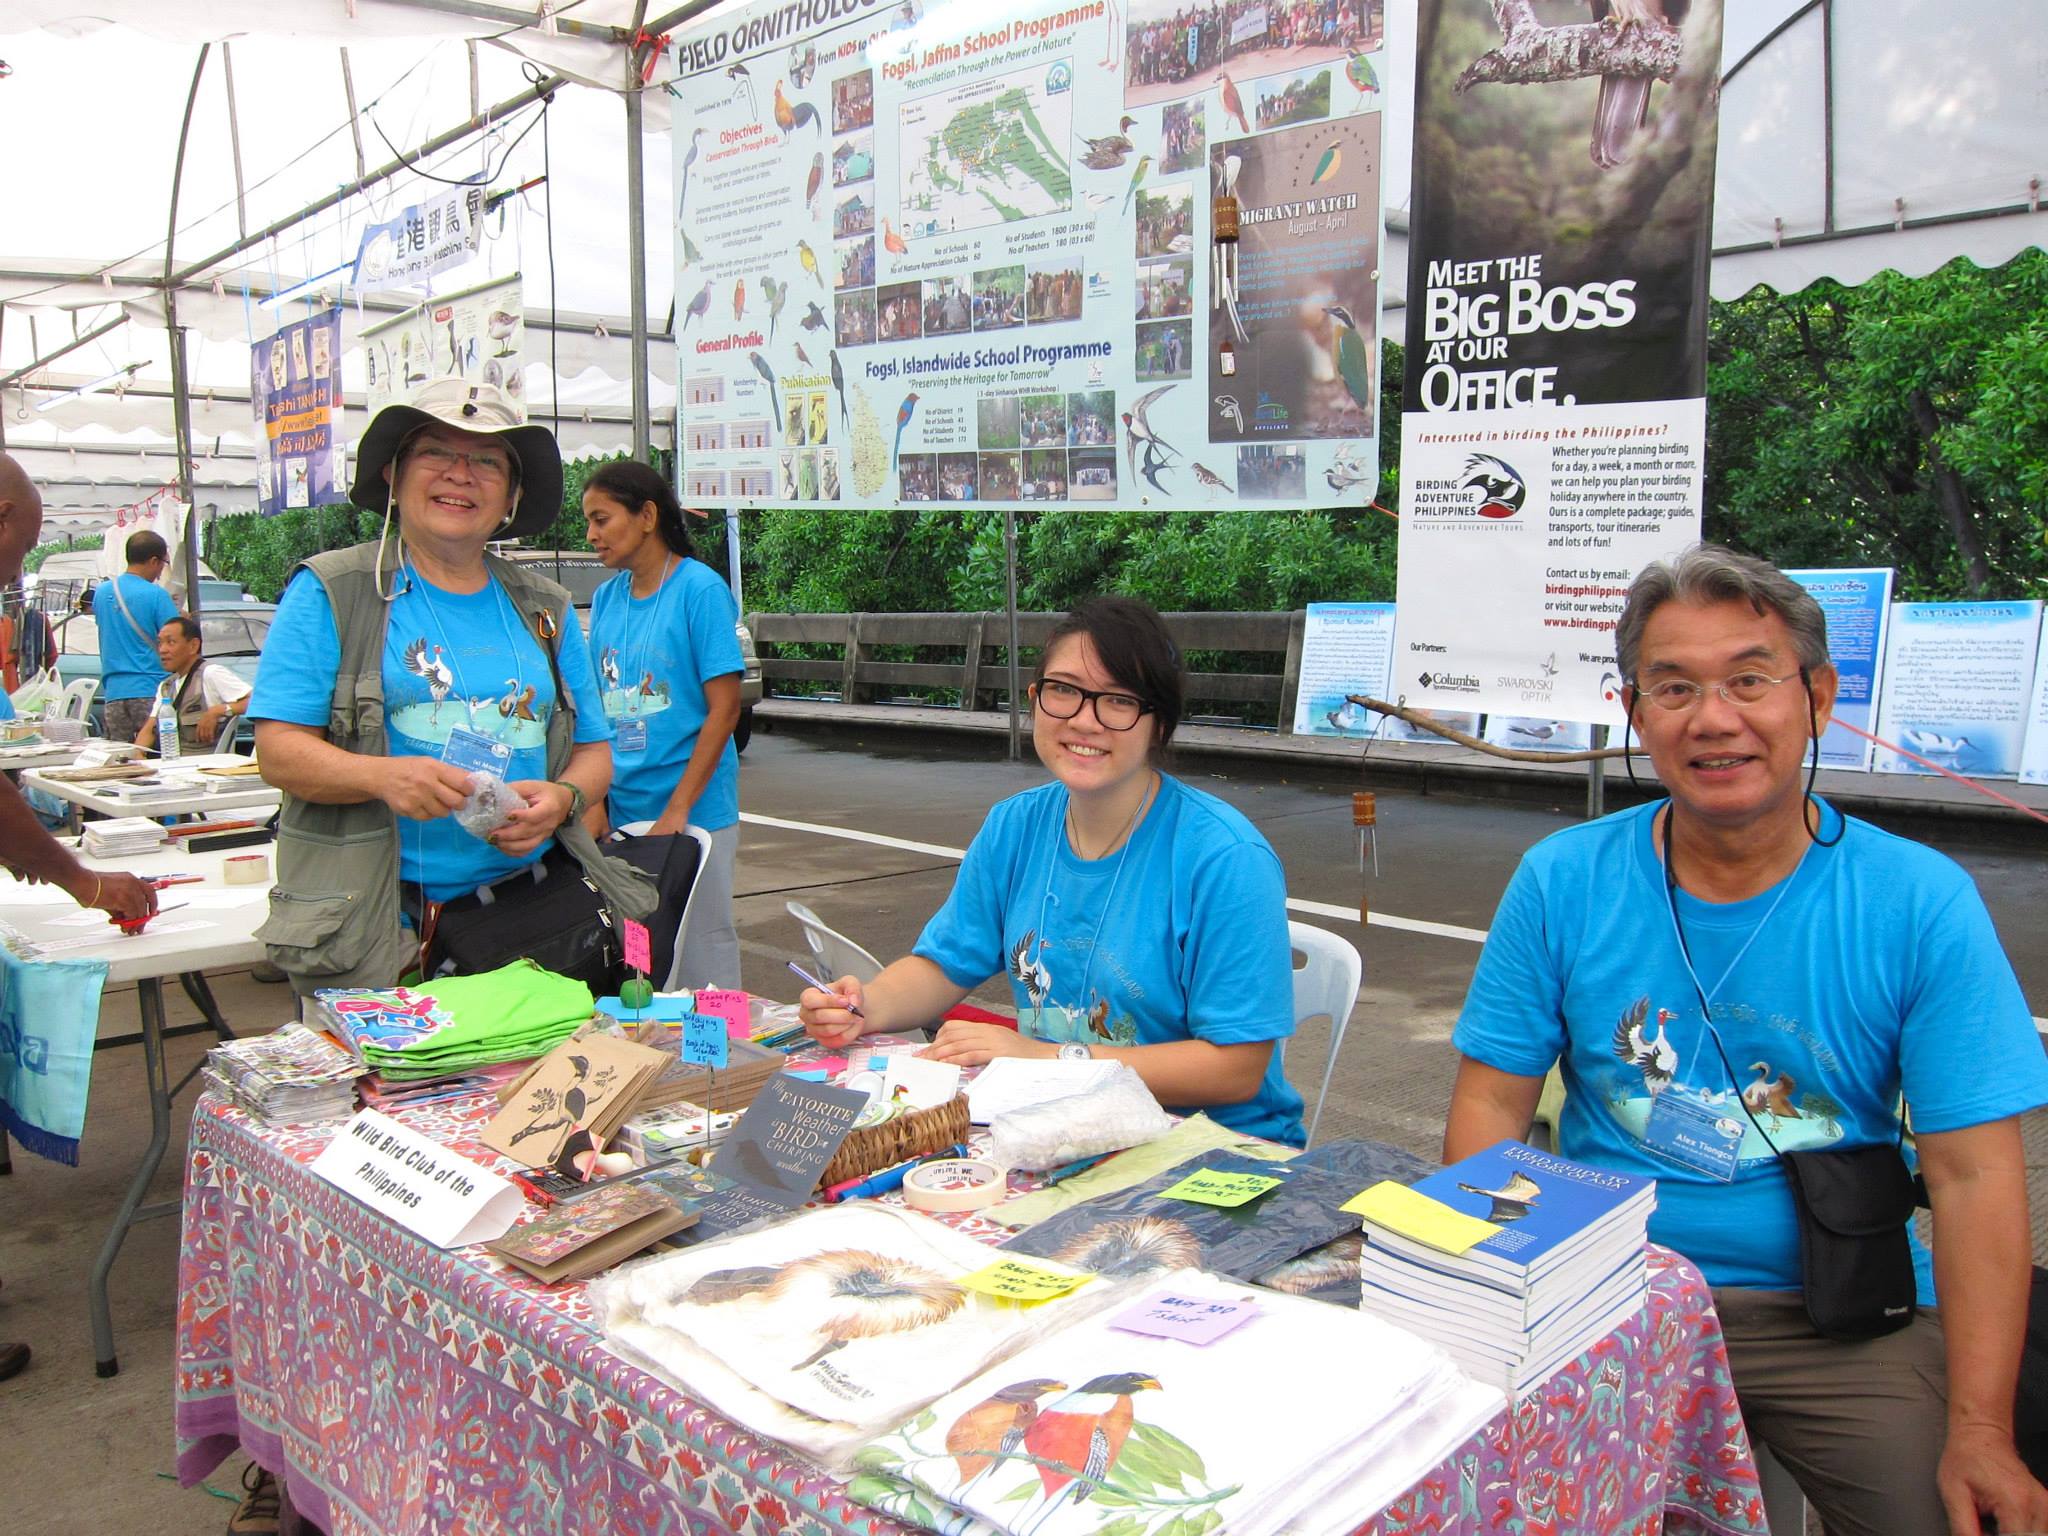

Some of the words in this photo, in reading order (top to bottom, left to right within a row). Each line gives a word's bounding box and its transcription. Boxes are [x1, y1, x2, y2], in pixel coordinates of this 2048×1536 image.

[922, 44, 960, 68] Jaffna
[964, 26, 1010, 55] School
[1014, 2, 1104, 43] Programme
[678, 33, 728, 75] FIELD
[818, 49, 836, 66] from
[837, 40, 857, 61] KIDS
[858, 37, 866, 50] to
[958, 59, 988, 77] Through
[991, 54, 1003, 67] the
[1005, 49, 1030, 66] Power
[1031, 44, 1041, 56] of
[720, 123, 763, 145] Objectives
[741, 140, 763, 153] Through
[1239, 200, 1303, 226] MIGRANT
[1306, 193, 1358, 216] WATCH
[1288, 220, 1317, 237] August
[1327, 213, 1348, 230] April
[1024, 241, 1049, 253] Teachers
[921, 258, 952, 271] Appreciation
[1427, 259, 1496, 287] MEET
[1496, 254, 1542, 282] THE
[1424, 287, 1500, 341] BIG
[1508, 279, 1637, 335] BOSS
[696, 334, 731, 354] General
[732, 330, 764, 349] Profile
[1425, 341, 1455, 364] AT
[1458, 336, 1508, 362] OUR
[902, 352, 970, 375] Islandwide
[974, 346, 1019, 368] School
[1023, 341, 1112, 365] Programme
[780, 373, 831, 389] Publication
[950, 374, 961, 385] the
[963, 372, 995, 386] Heritage
[997, 371, 1008, 382] for
[1419, 432, 1482, 443] Interested
[1487, 431, 1498, 440] in
[1503, 430, 1550, 442] birding
[1555, 428, 1576, 439] the
[1582, 424, 1669, 440] Philippines?
[1552, 446, 1589, 456] Whether
[1592, 446, 1616, 458] you're
[1618, 444, 1656, 458] planning
[1659, 443, 1689, 455] birding
[1551, 462, 1563, 472] for
[1565, 464, 1570, 472] a
[1573, 461, 1590, 473] day,
[1592, 463, 1596, 471] a
[1599, 461, 1624, 472] week,
[1626, 463, 1631, 471] a
[1633, 460, 1662, 471] month
[1664, 462, 1673, 470] or
[1416, 480, 1457, 489] BIRDING
[1551, 478, 1563, 486] we
[1565, 478, 1579, 486] can
[1582, 476, 1601, 488] help
[1603, 478, 1618, 488] you
[1620, 476, 1639, 488] plan
[1641, 477, 1660, 487] your
[1662, 475, 1691, 487] birding
[1415, 494, 1474, 502] ADVENTURE
[1550, 491, 1581, 503] holiday
[1583, 491, 1625, 503] anywhere
[1627, 491, 1635, 501] in
[1638, 492, 1652, 501] the
[1654, 492, 1687, 503] country.
[1415, 507, 1476, 516] PHILIPPINES
[1549, 507, 1568, 517] Ours
[1570, 506, 1576, 516] is
[1578, 509, 1583, 517] a
[1586, 507, 1626, 519] complete
[1549, 522, 1594, 534] transports,
[1597, 523, 1614, 532] tour
[1616, 522, 1661, 532] itineraries
[1548, 537, 1563, 547] and
[1565, 537, 1580, 547] lots
[1582, 537, 1592, 547] of
[1593, 537, 1611, 547] fun!
[1545, 567, 1577, 579] Contact
[1579, 570, 1589, 579] us
[1590, 569, 1601, 582] by
[1602, 570, 1631, 580] email:
[1545, 602, 1554, 611] or
[1555, 601, 1572, 611] visit
[1574, 603, 1588, 612] our
[1589, 602, 1624, 613] website
[1410, 643, 1421, 651] Our
[1579, 653, 1590, 662] We
[1591, 655, 1601, 663] are
[1601, 656, 1619, 665] prou
[1433, 672, 1480, 687] Columbia
[1497, 677, 1553, 691] SWAROVSKI
[1521, 691, 1552, 703] OPTIK
[779, 1092, 854, 1122] FAVORITE
[792, 1107, 845, 1136] Weather
[772, 1121, 818, 1149] BIRD
[1675, 1133, 1697, 1147] Alex
[351, 1120, 382, 1146] Wild
[378, 1135, 409, 1160] Bird
[405, 1150, 437, 1176] Club
[434, 1167, 454, 1185] of
[449, 1175, 475, 1197] the
[766, 1140, 824, 1164] CHIRPING
[356, 1161, 422, 1209] Philippines
[1589, 1178, 1622, 1189] ASIA
[1607, 1175, 1630, 1185] TO
